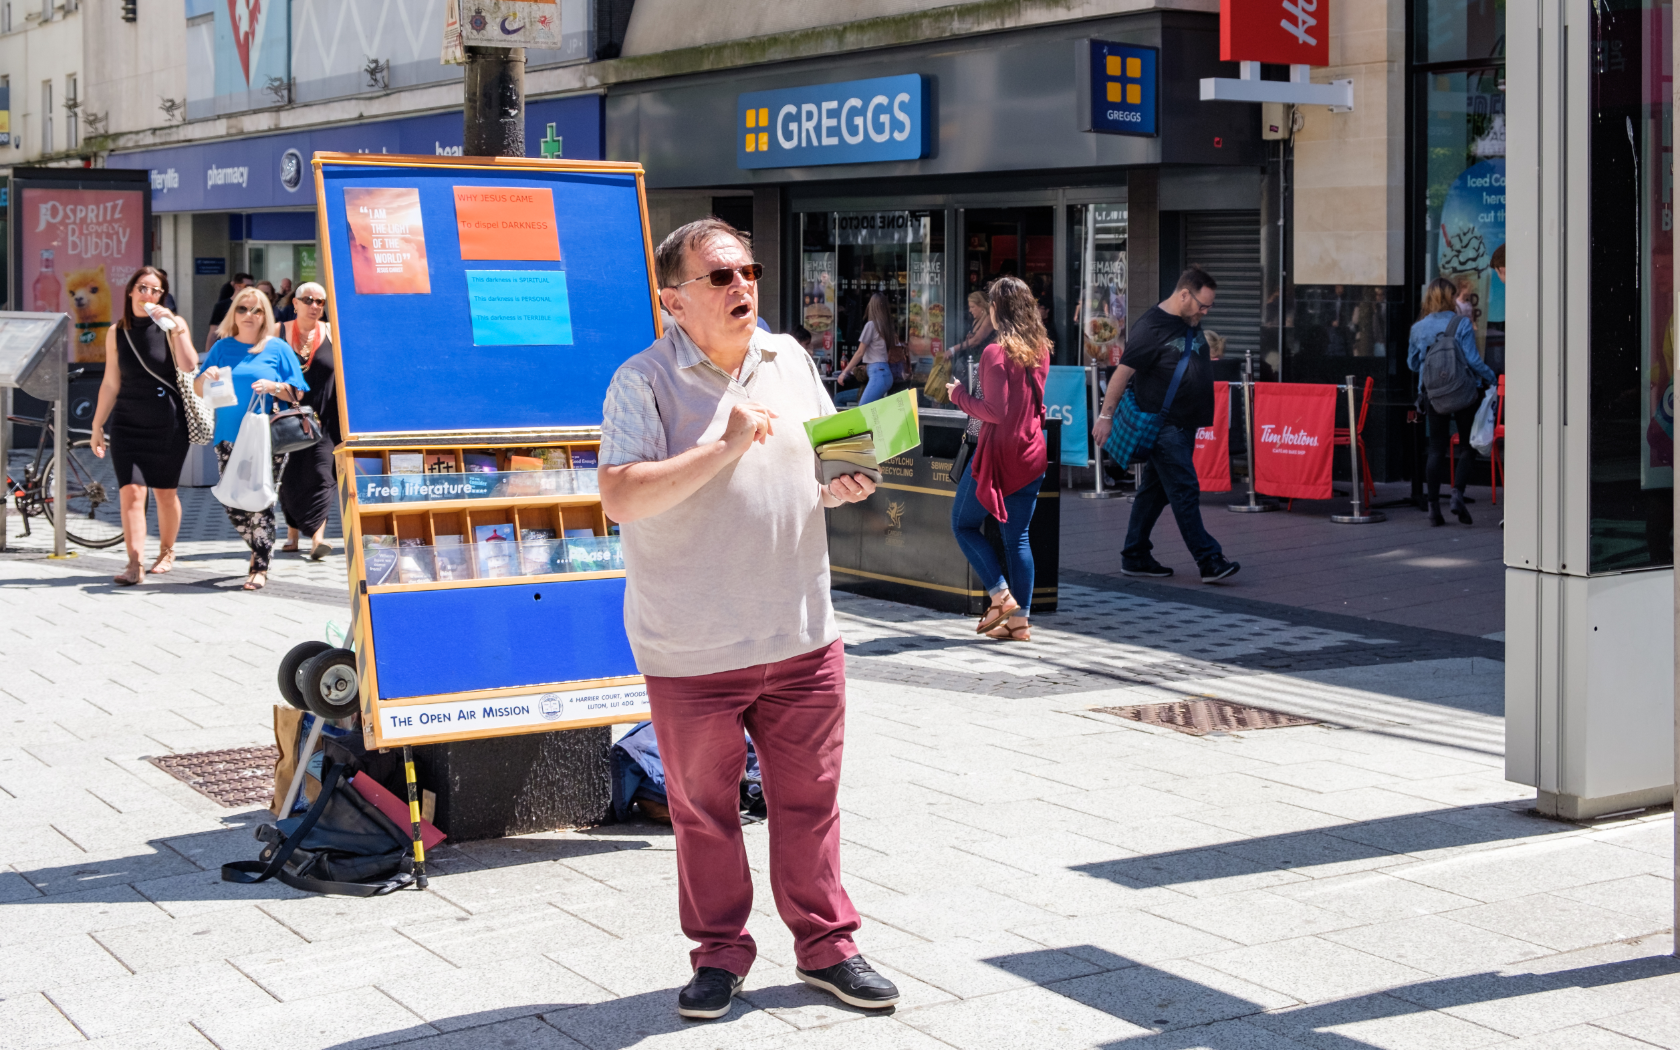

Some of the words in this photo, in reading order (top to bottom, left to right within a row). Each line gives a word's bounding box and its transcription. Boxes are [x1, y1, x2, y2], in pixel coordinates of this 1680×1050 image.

[777, 92, 911, 150] GREGGS
[1107, 110, 1141, 122] GREGGS
[207, 164, 249, 189] pharmacy
[1467, 174, 1490, 187] Iced
[458, 194, 478, 202] WHY
[480, 194, 507, 202] JESUS
[510, 195, 533, 203] CAME
[65, 199, 125, 224] SPRITZ
[374, 208, 387, 219] AM
[1478, 210, 1494, 222] cut
[83, 223, 120, 234] LOVELY
[371, 223, 386, 234] THE
[388, 223, 409, 234] LIGHT
[461, 221, 472, 229] To
[475, 221, 499, 230] dispel
[501, 221, 548, 229] DARKNESS
[372, 238, 383, 249] OF
[384, 238, 399, 249] THE
[920, 262, 941, 273] MAKE
[1097, 261, 1121, 273] MAKE
[913, 273, 941, 285] LUNCH
[1261, 424, 1281, 443] Tim
[881, 467, 914, 478] RECYCLING
[367, 483, 399, 497] Free
[588, 702, 608, 710] LUTON,
[390, 715, 413, 727] THE
[419, 712, 451, 725] OPEN
[457, 709, 476, 721] AIR
[483, 705, 530, 718] MISSION
